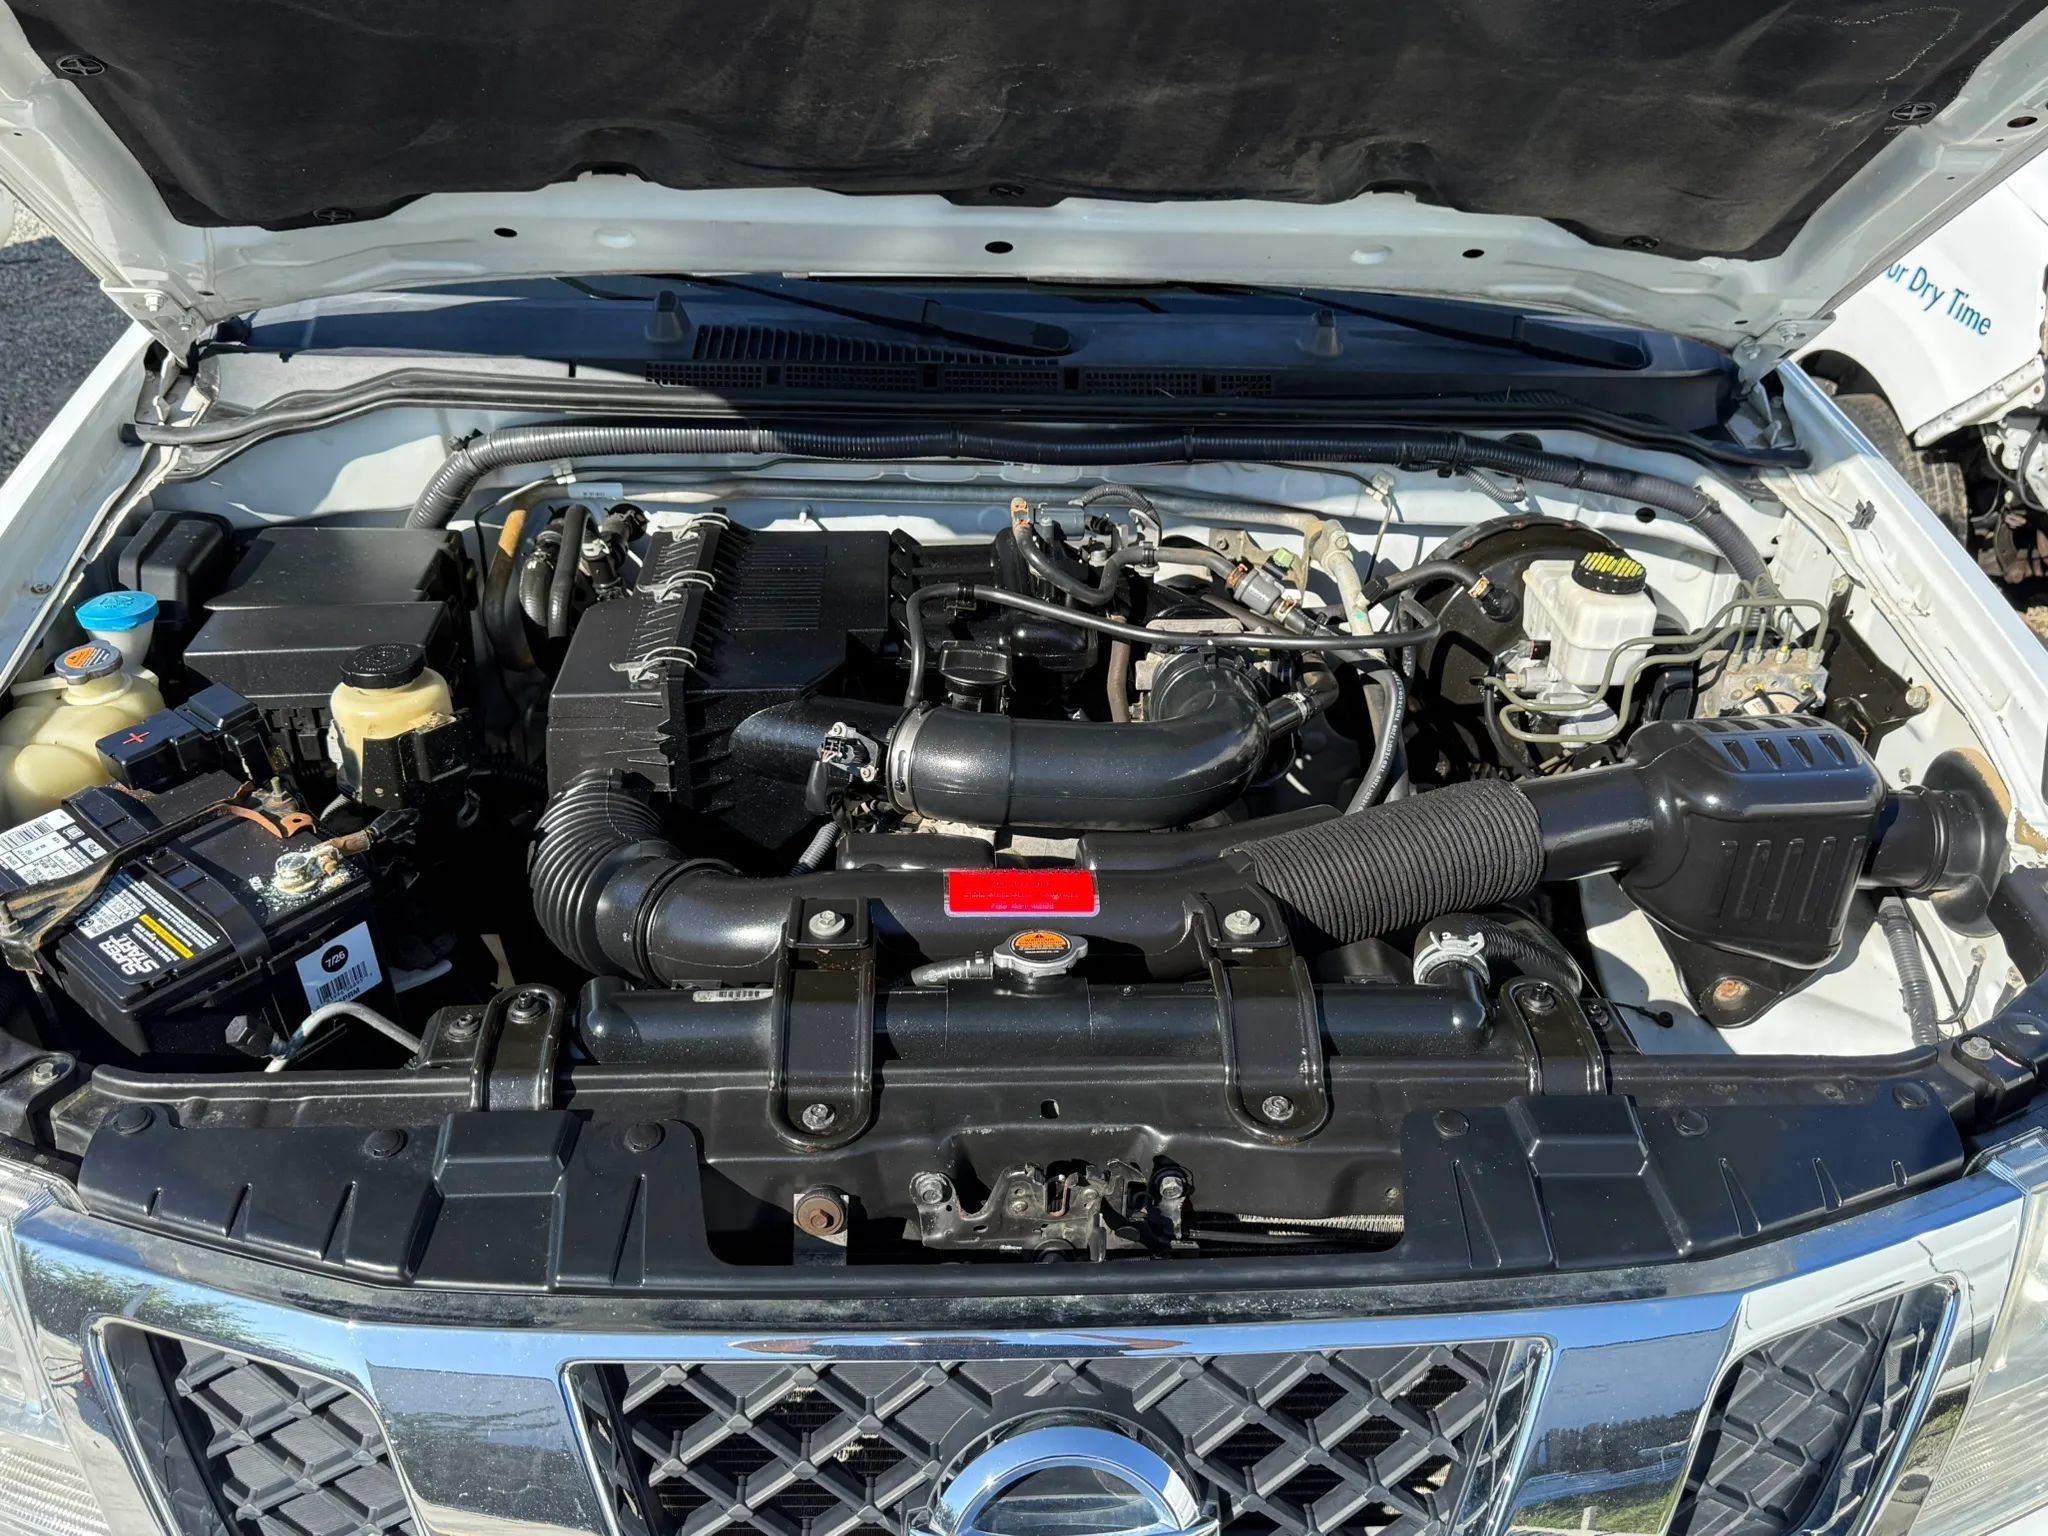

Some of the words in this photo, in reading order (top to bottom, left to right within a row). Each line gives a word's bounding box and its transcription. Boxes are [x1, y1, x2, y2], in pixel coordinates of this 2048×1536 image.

[1887, 264, 1908, 282] ur
[1908, 266, 1945, 311] Dry
[1947, 288, 1991, 335] Time
[98, 940, 137, 975] SUPER
[109, 935, 161, 973] START
[325, 950, 346, 968] 7/26
